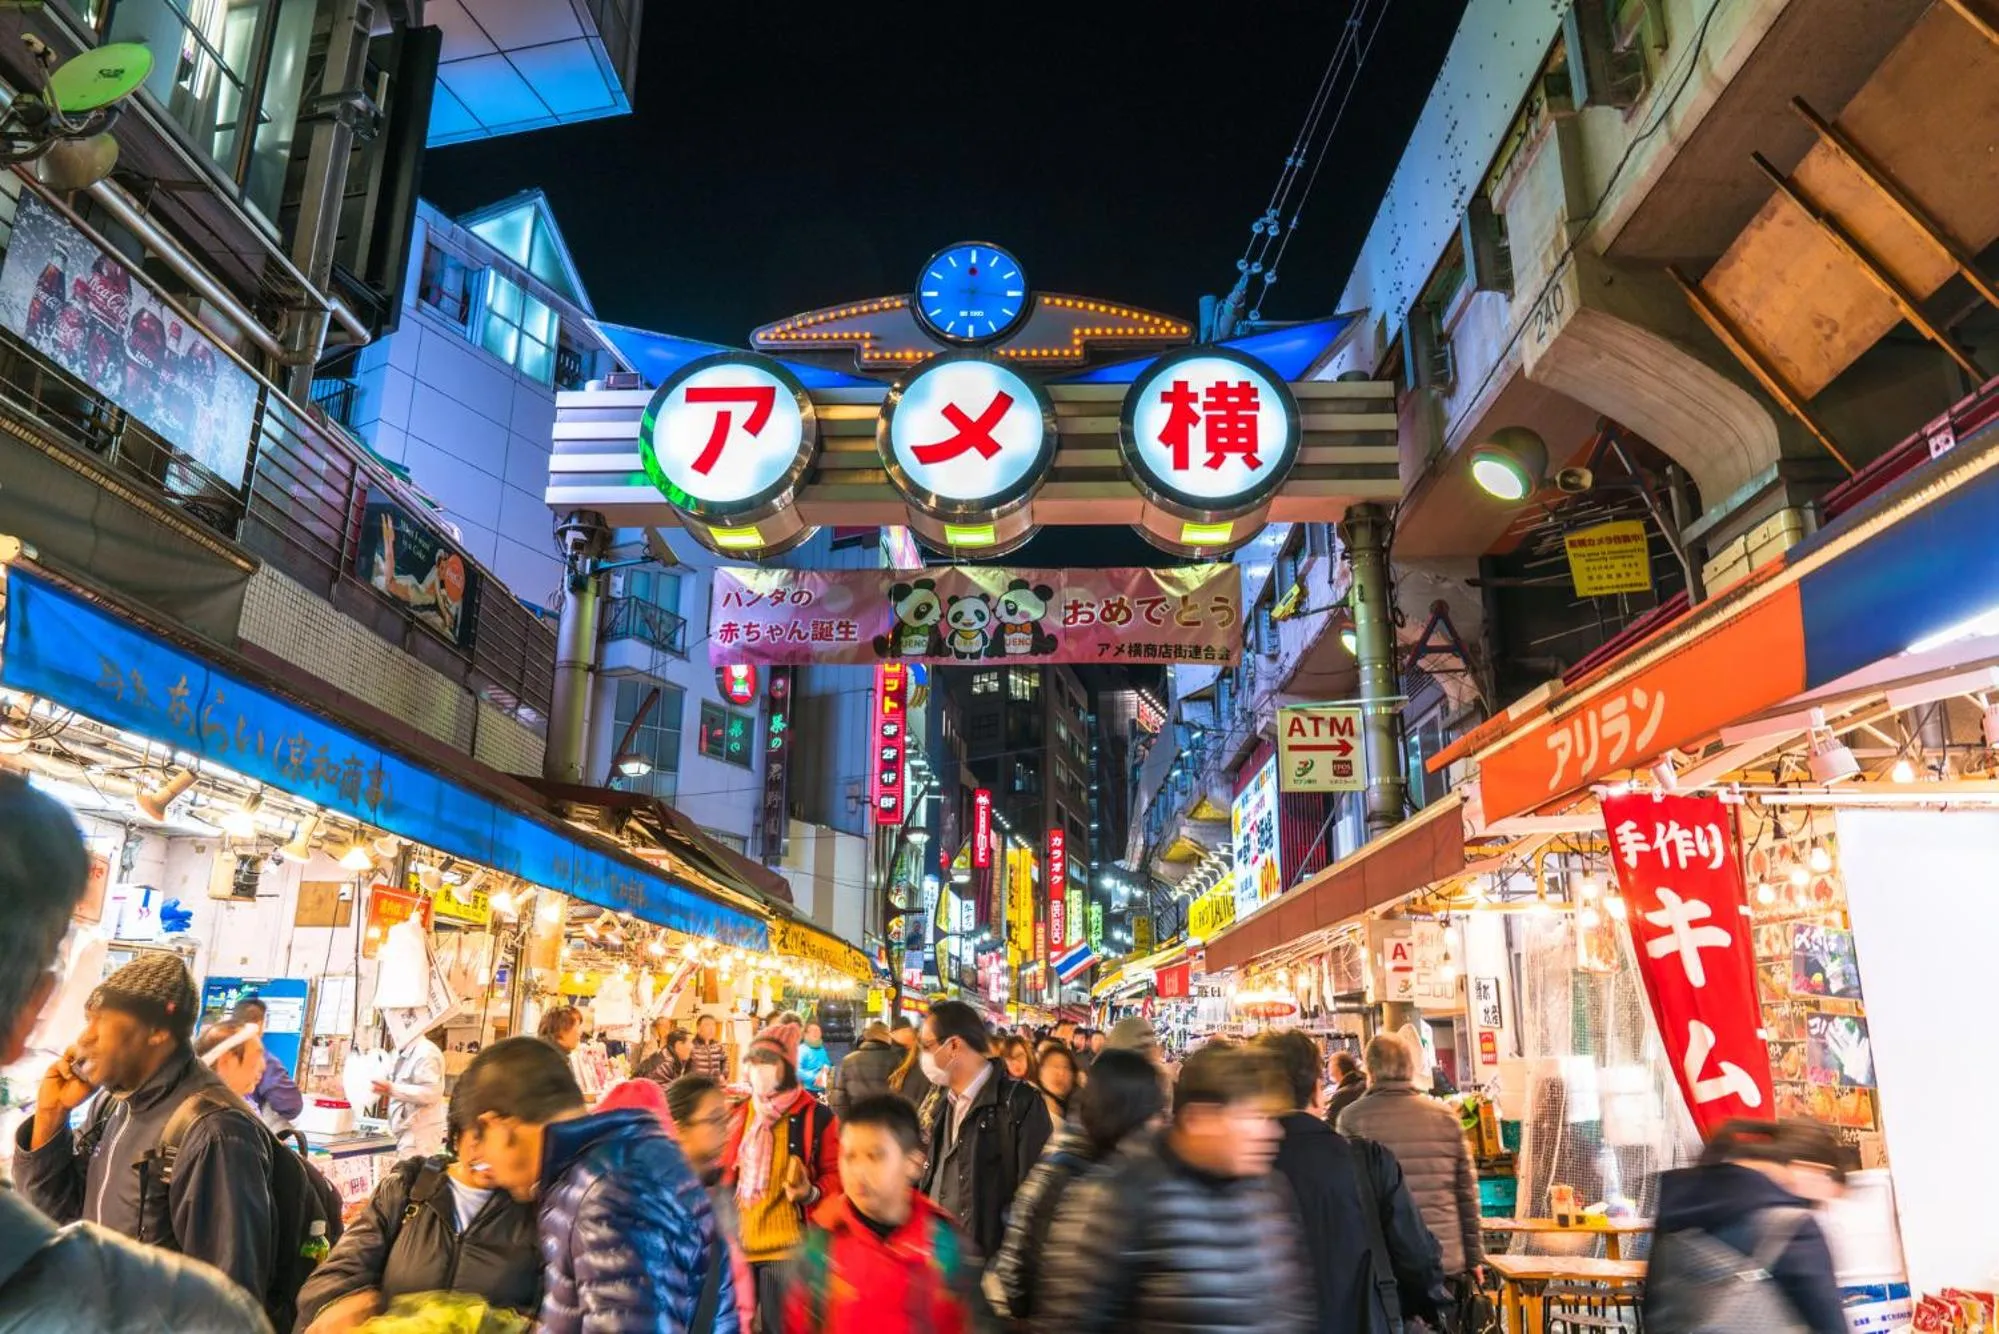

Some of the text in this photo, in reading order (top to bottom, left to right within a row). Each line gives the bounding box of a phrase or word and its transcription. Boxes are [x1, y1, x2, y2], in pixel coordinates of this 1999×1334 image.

[1534, 283, 1564, 343] 240
[722, 585, 813, 608] パンダの
[1063, 595, 1236, 628] おめでとう
[719, 620, 858, 643] 赤ちゃん誕生
[1097, 642, 1231, 661] アメ横商店街連合会
[883, 725, 897, 735] 3F
[1288, 716, 1354, 737] ATM
[1546, 687, 1664, 790] アリラン
[883, 749, 897, 759] 2F
[882, 774, 896, 783] 1F
[1615, 820, 1725, 870] 手作り
[1051, 836, 1063, 885] カラオケ
